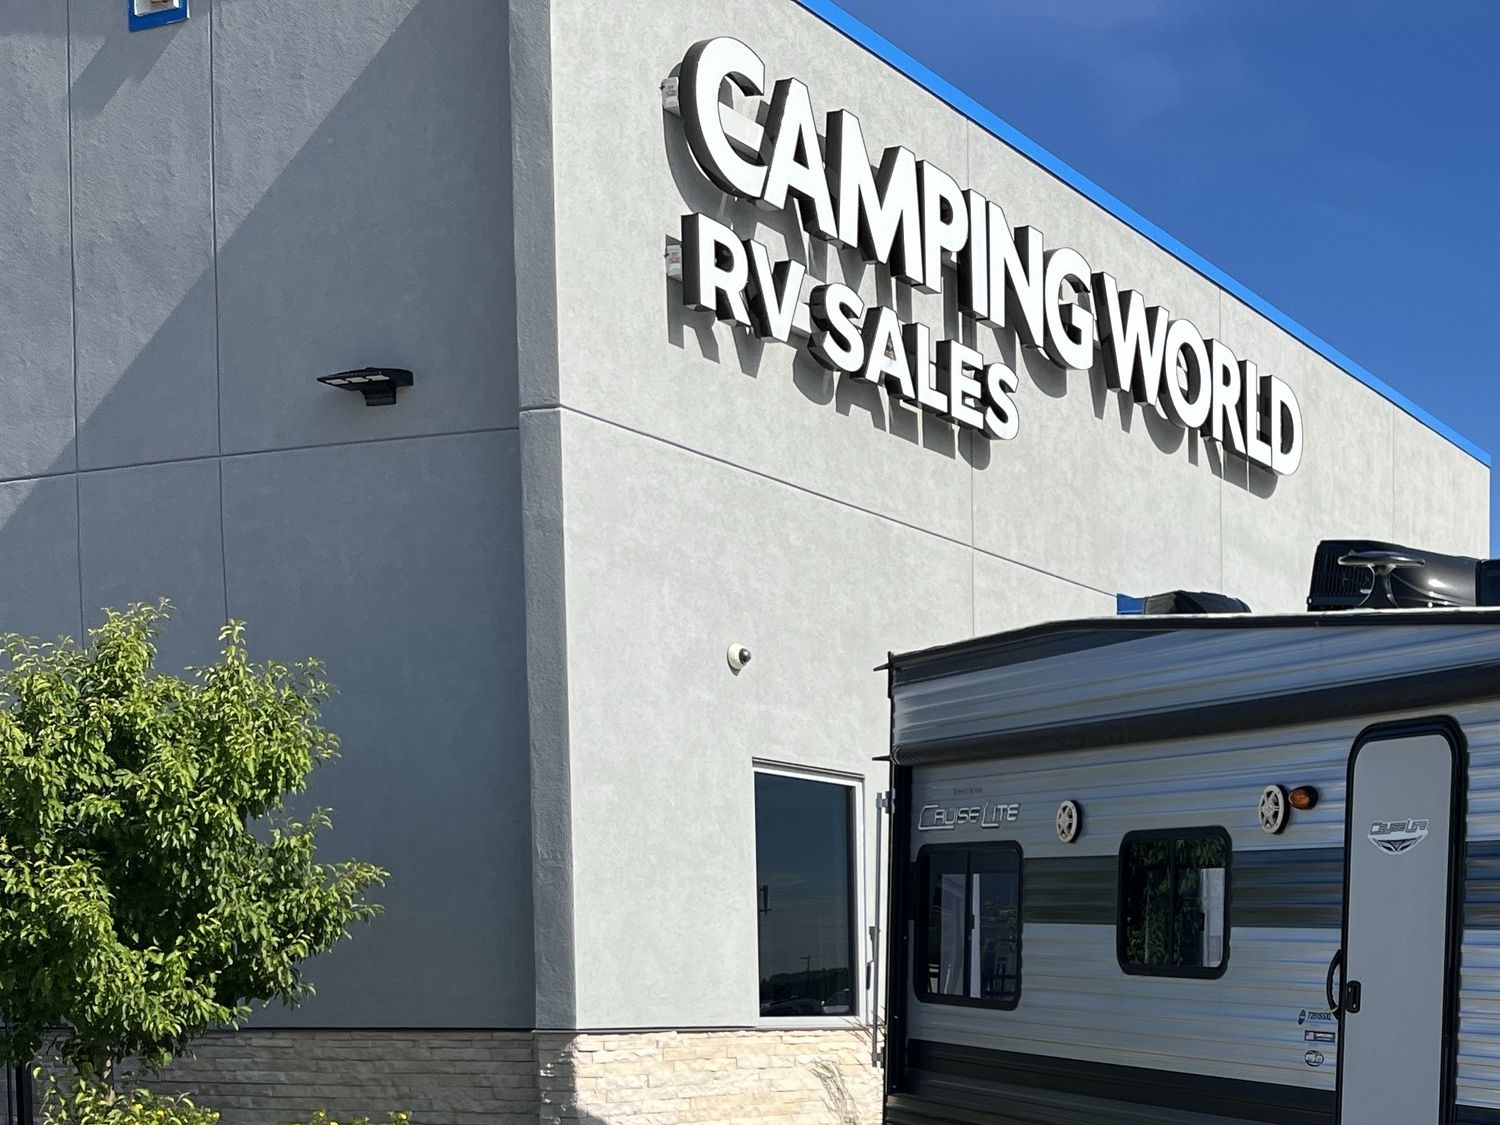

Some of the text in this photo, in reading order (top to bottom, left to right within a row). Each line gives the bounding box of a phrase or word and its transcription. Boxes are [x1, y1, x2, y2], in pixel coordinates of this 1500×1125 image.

[680, 36, 1302, 476] CAMPING WORLD
[681, 212, 1019, 440] RV SALES
